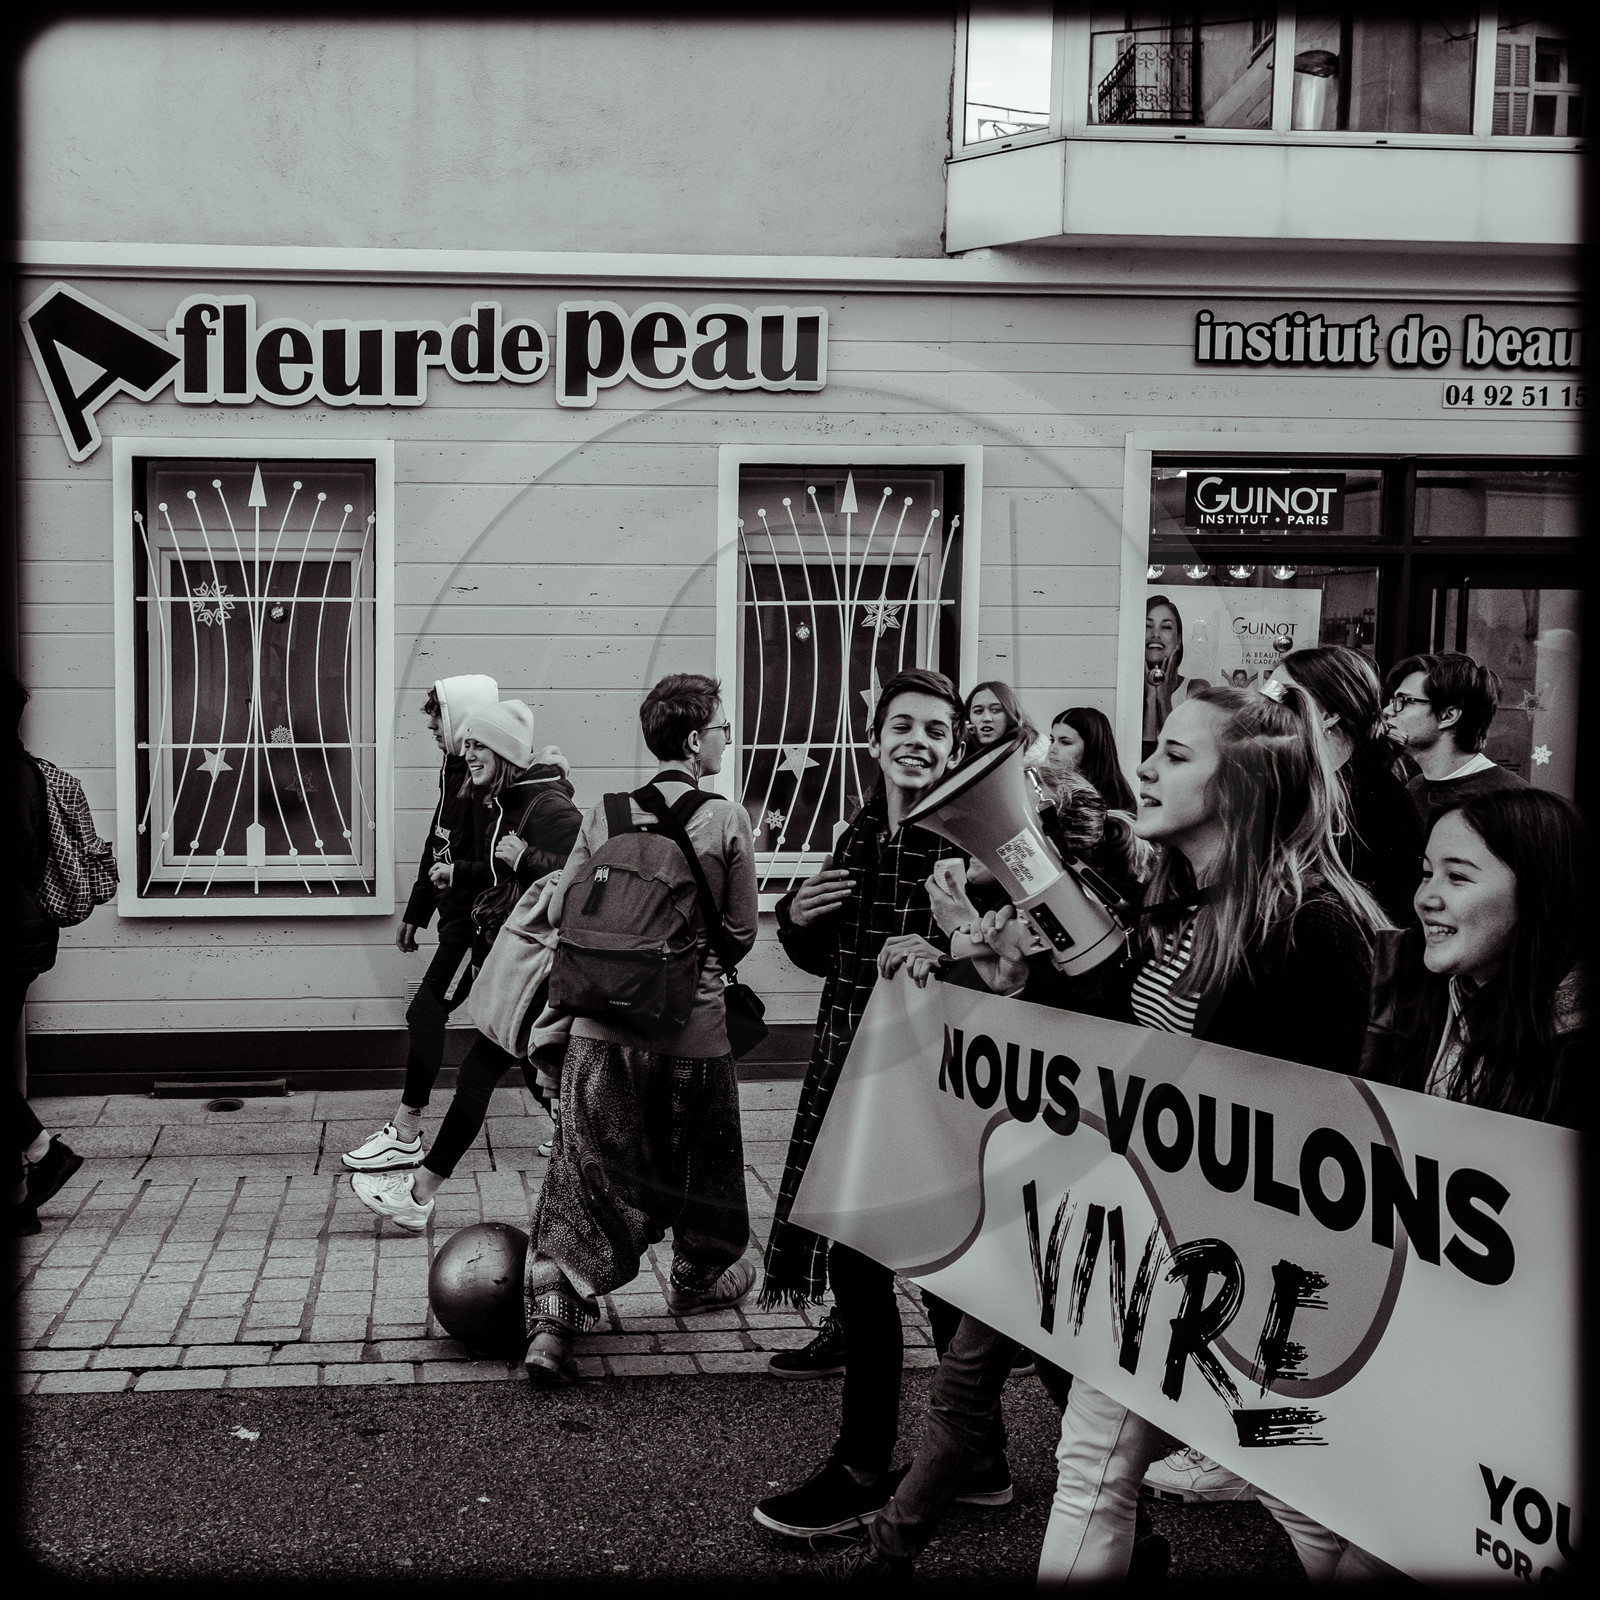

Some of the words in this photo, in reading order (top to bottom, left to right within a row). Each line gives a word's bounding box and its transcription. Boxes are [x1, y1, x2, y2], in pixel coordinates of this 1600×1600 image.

[1195, 309, 1379, 365] institut
[1387, 313, 1451, 366] de
[27, 288, 182, 454] A
[174, 301, 443, 398] fleur
[449, 306, 544, 377] de
[564, 309, 822, 397] peau
[1445, 384, 1475, 406] 04
[1484, 385, 1513, 406] 92
[1522, 386, 1548, 407] 51
[1561, 386, 1589, 407] 15
[1194, 476, 1338, 515] GUINOT
[1200, 514, 1269, 525] INSTITUT
[1287, 515, 1329, 525] PARIS
[998, 848, 1007, 857] de
[1004, 843, 1012, 852] de
[1011, 840, 1028, 860] Alpine
[938, 1023, 1081, 1136] NOUS
[1097, 1066, 1515, 1286] VOULONS
[1022, 1179, 1329, 1448] VIVRE
[1475, 1527, 1533, 1584] FOR
